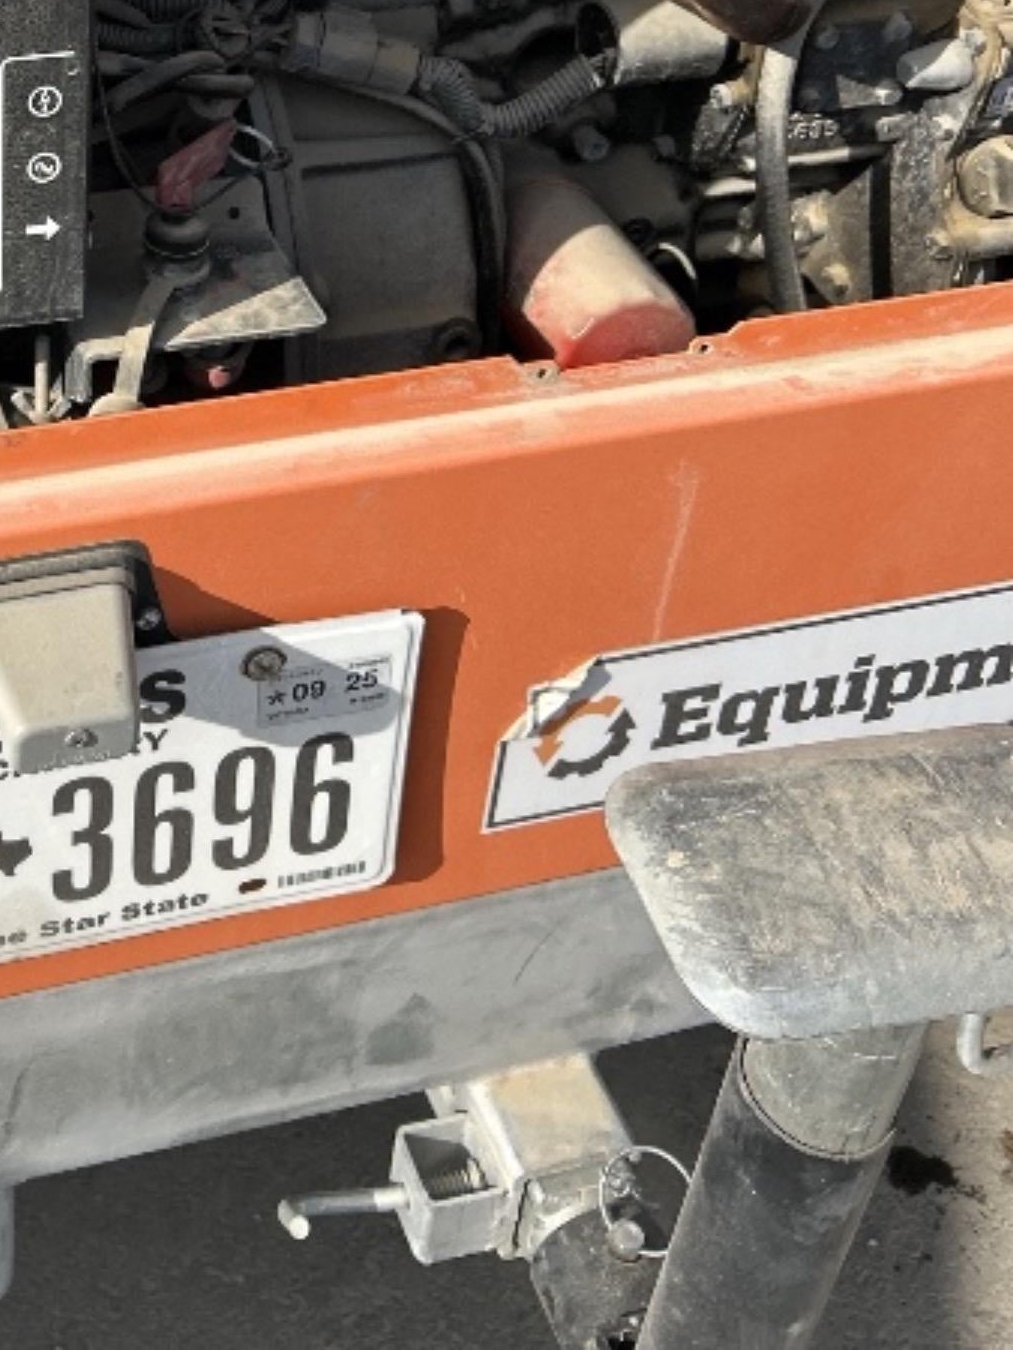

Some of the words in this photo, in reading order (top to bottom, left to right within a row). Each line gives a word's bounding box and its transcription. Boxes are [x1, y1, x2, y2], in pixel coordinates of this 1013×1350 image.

[292, 679, 328, 703] 09
[344, 668, 379, 693] 25
[51, 731, 357, 902] 3696
[40, 909, 111, 939] Star
[120, 891, 210, 923] State
